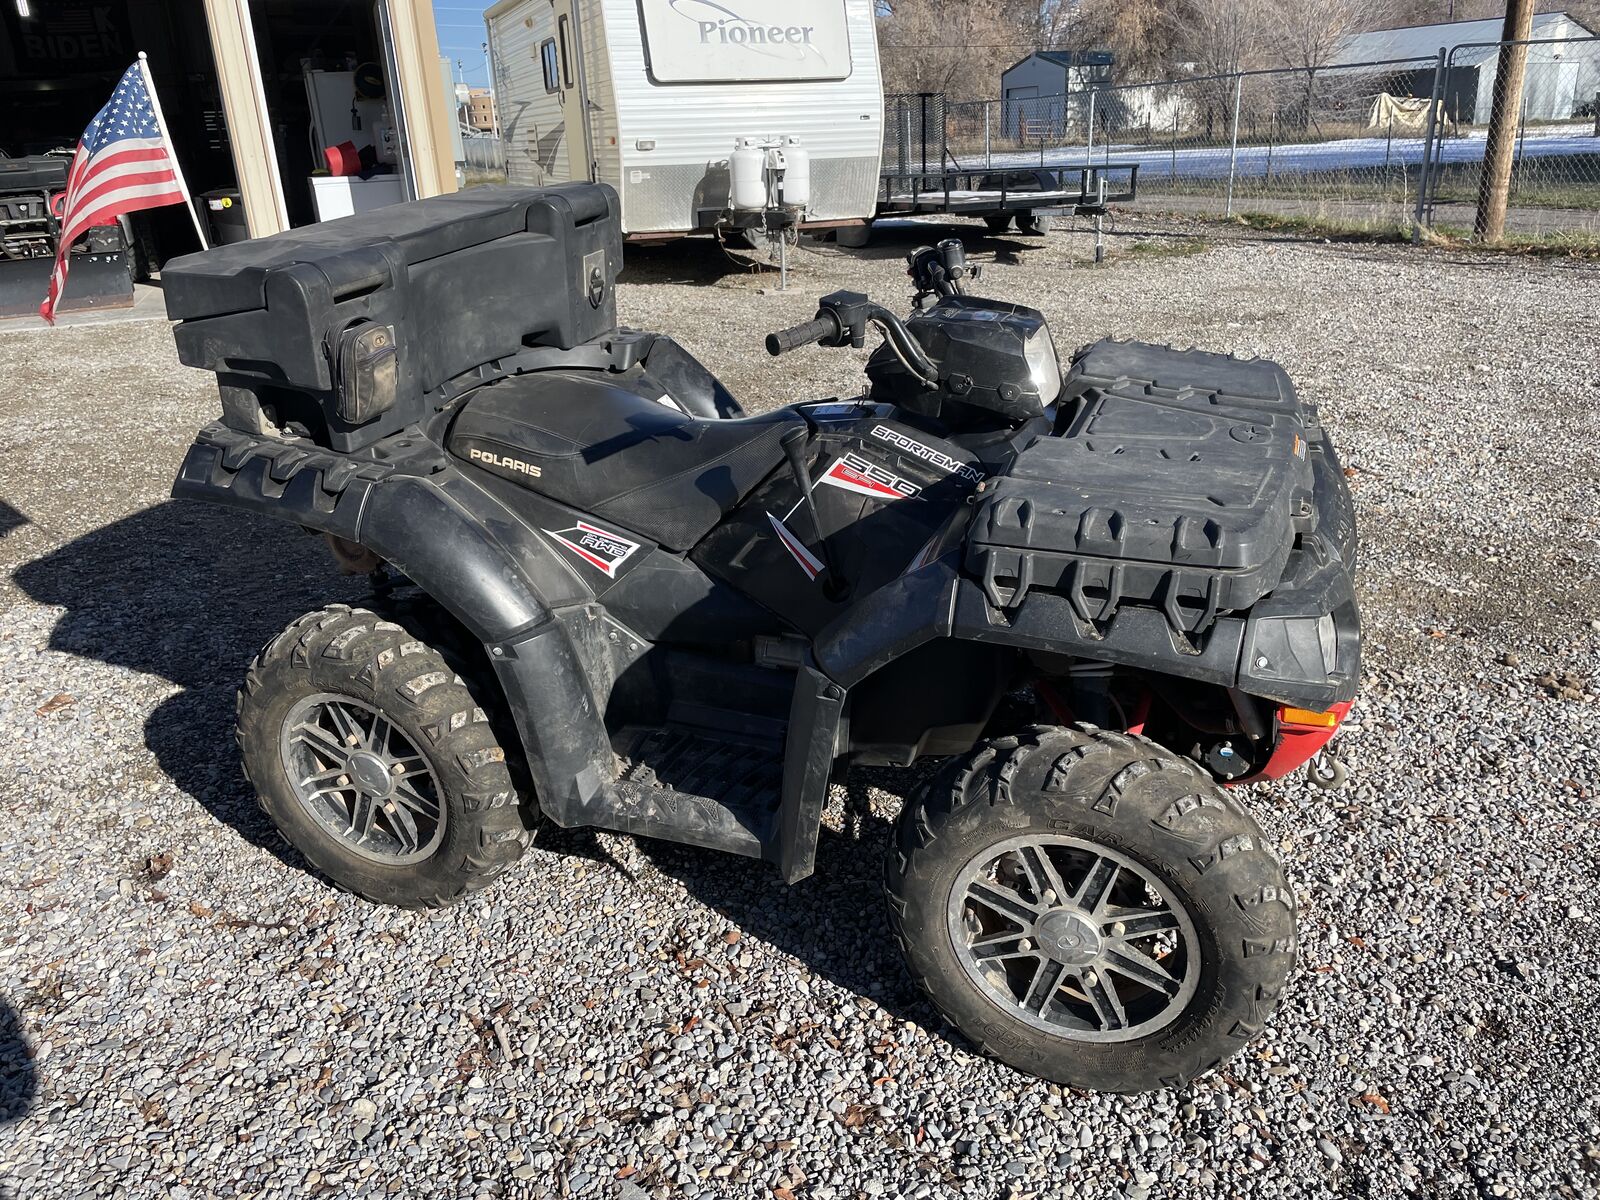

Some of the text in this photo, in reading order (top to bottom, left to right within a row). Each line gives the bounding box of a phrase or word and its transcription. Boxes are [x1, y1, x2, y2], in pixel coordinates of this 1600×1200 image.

[22, 33, 124, 59] BIDEN
[698, 19, 814, 45] Pioneer
[470, 448, 542, 478] POLARIS
[870, 424, 986, 484] SPORTSMAN
[842, 452, 923, 499] 550
[580, 535, 629, 559] AWD
